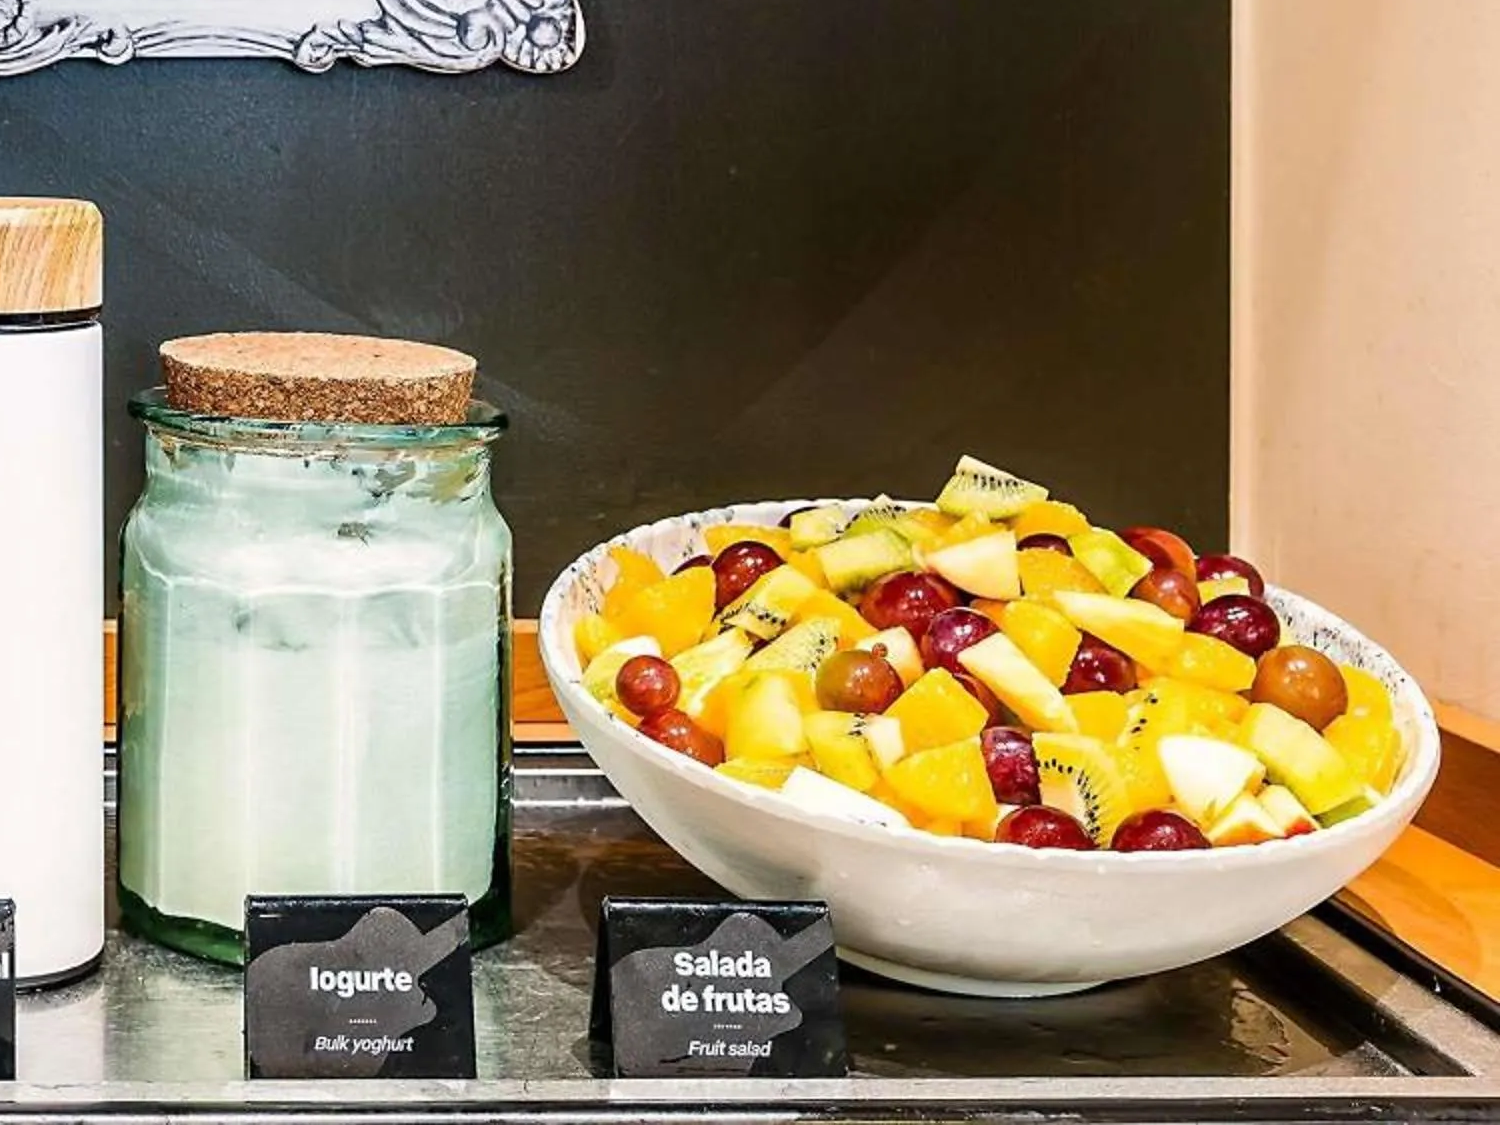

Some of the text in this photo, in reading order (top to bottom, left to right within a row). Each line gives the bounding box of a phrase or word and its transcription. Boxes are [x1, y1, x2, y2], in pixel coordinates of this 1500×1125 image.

[673, 949, 772, 978] Salada
[309, 966, 413, 998] Iogurte
[661, 983, 791, 1014] de frutas
[314, 1034, 414, 1056] Bulk yoghurt
[687, 1039, 773, 1057] Fruit salad
